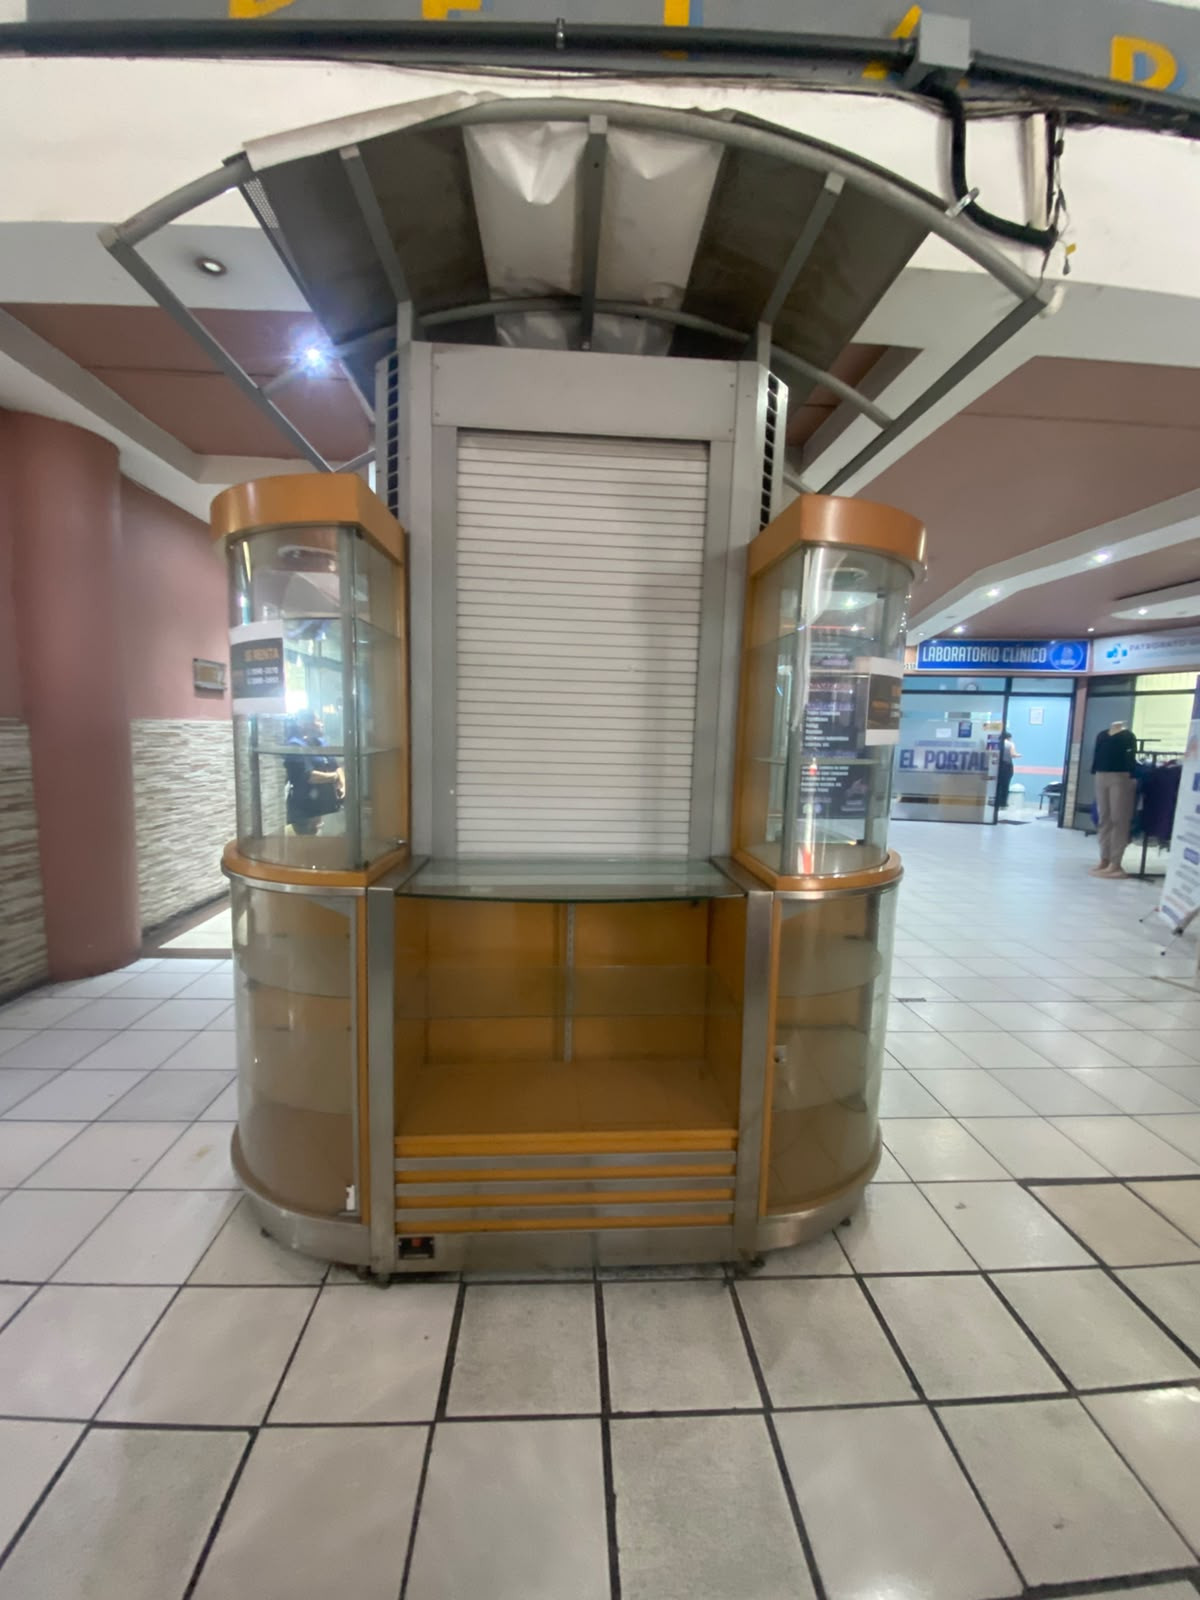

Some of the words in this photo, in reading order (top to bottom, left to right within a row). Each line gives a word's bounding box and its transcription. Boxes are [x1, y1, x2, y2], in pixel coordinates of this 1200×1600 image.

[922, 646, 999, 663] LABORATORIO
[899, 749, 918, 769] EL
[923, 750, 989, 771] PORTAL
